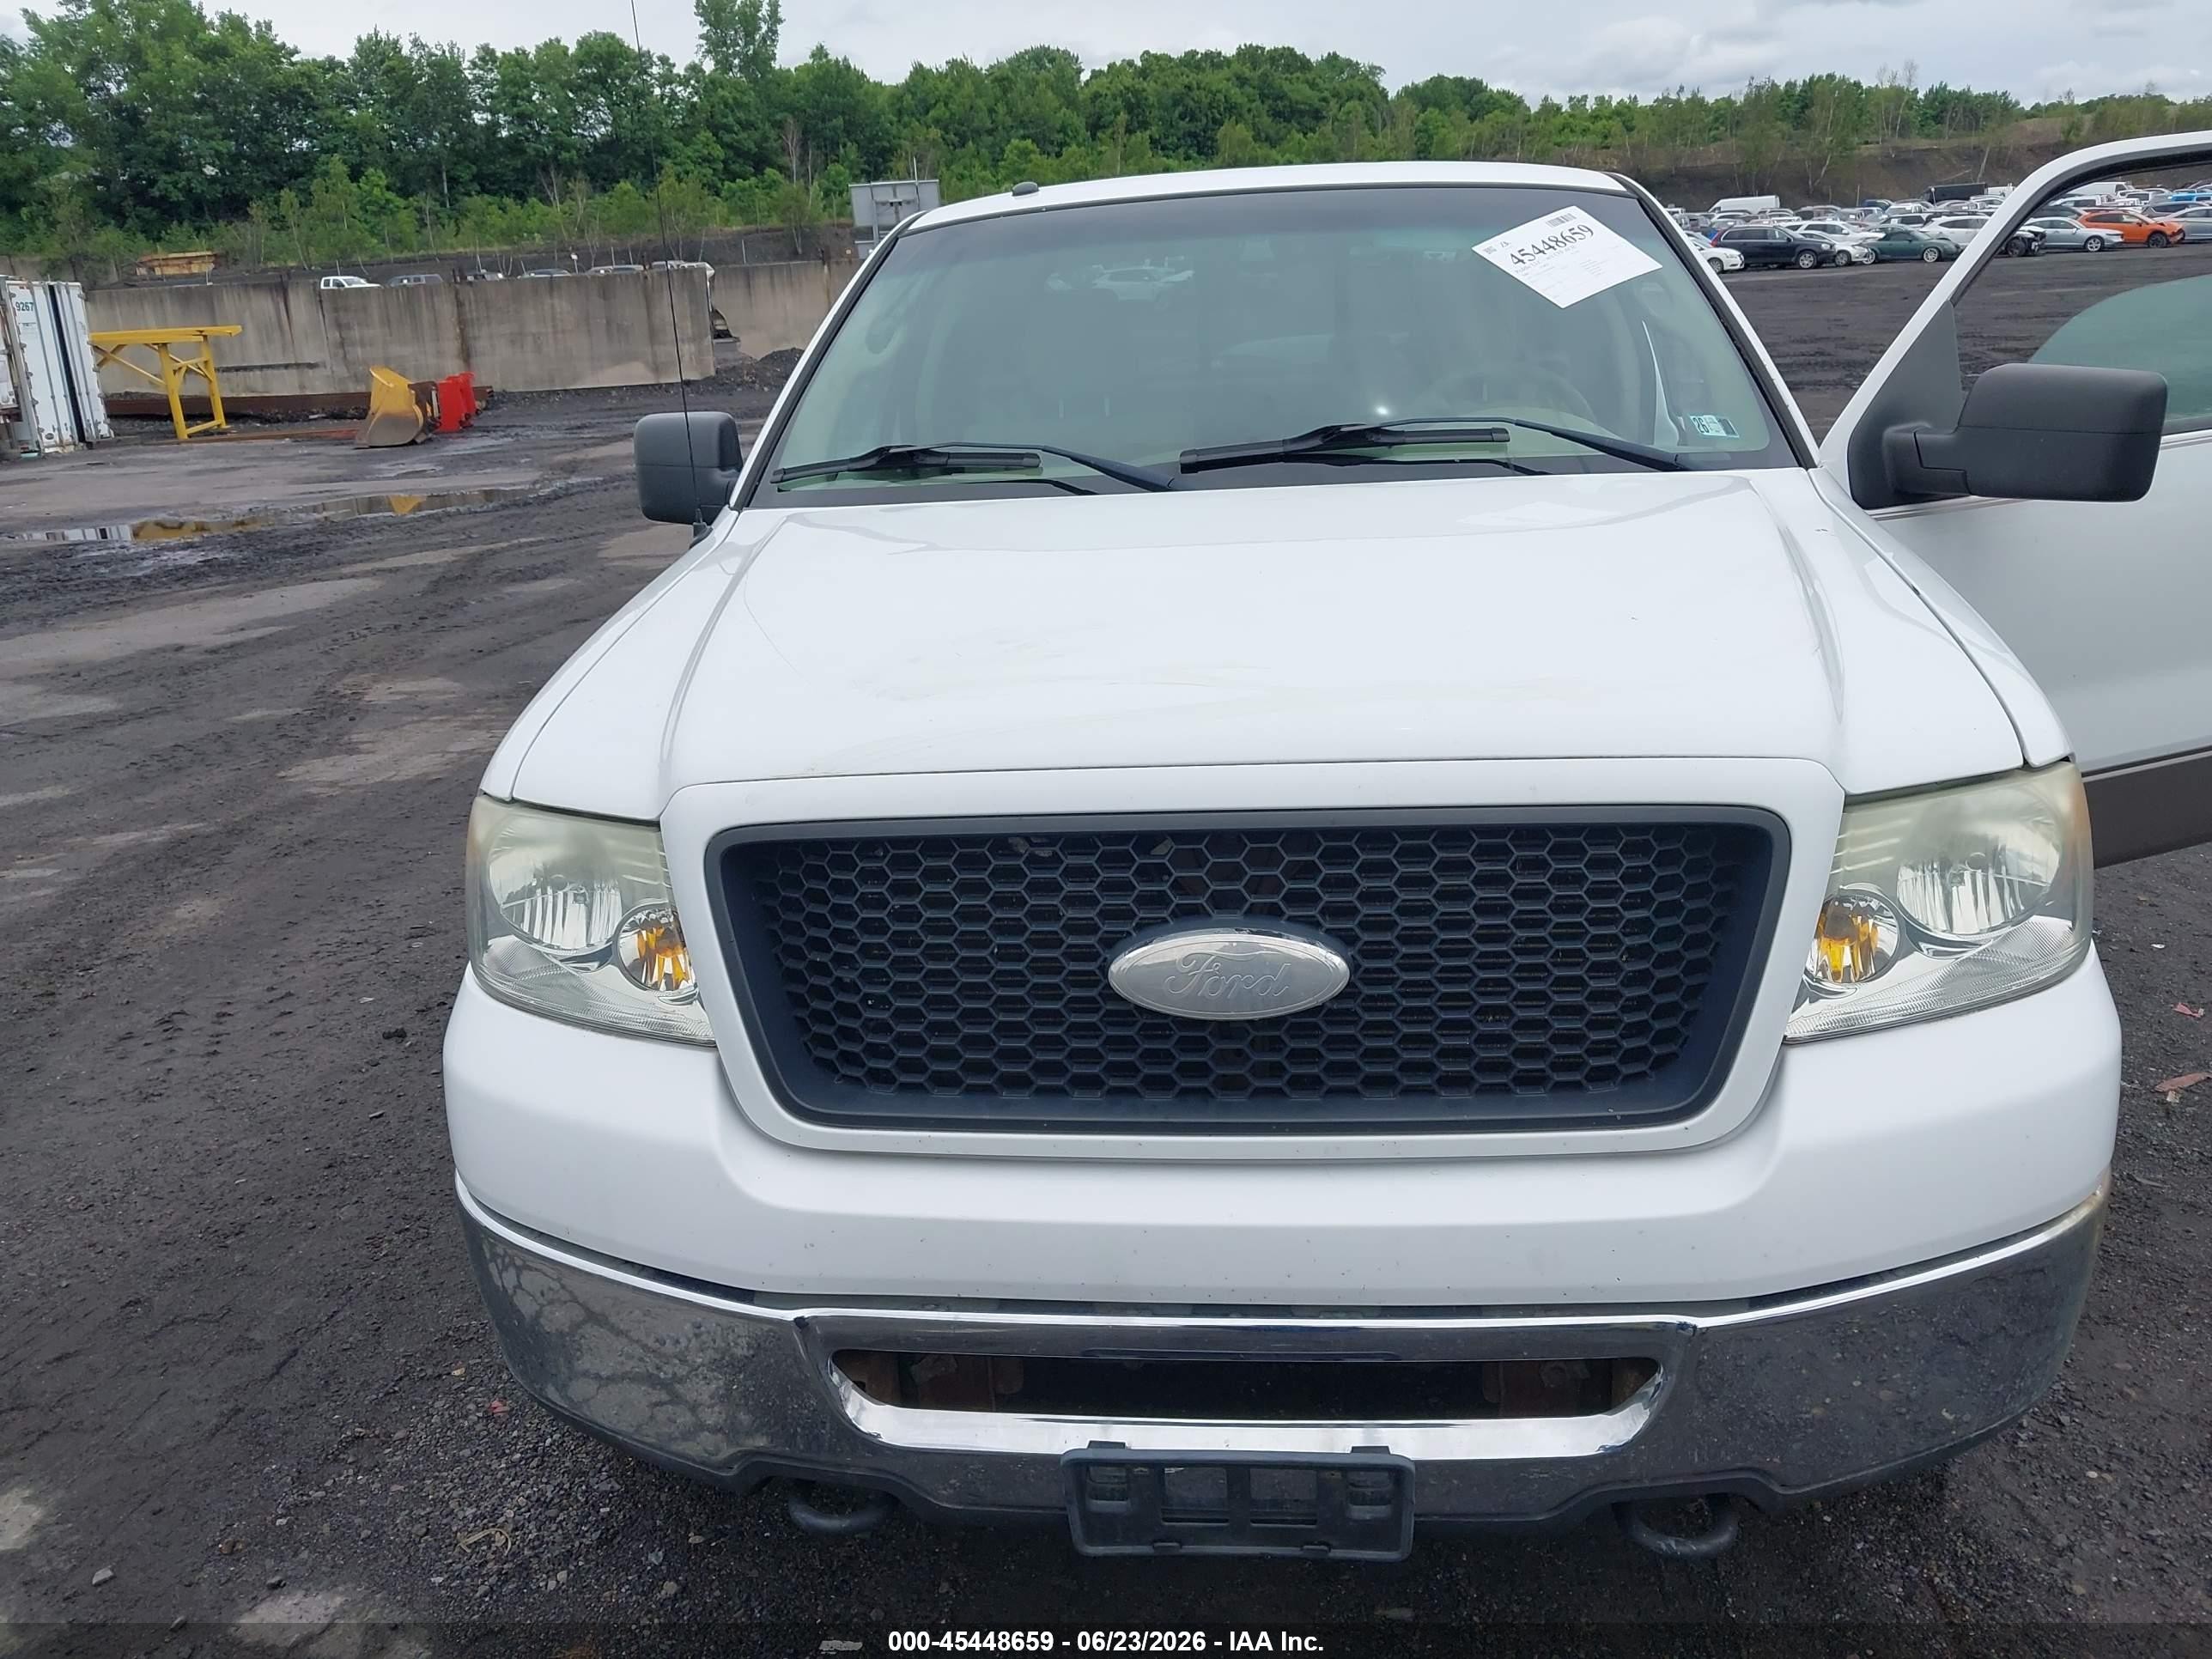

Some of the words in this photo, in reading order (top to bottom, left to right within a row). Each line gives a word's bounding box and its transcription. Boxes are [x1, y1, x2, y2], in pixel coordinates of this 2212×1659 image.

[1510, 224, 1594, 265] 45448659
[15, 301, 34, 312] 9267
[1692, 417, 1710, 433] 26
[1164, 951, 1292, 999] Ford
